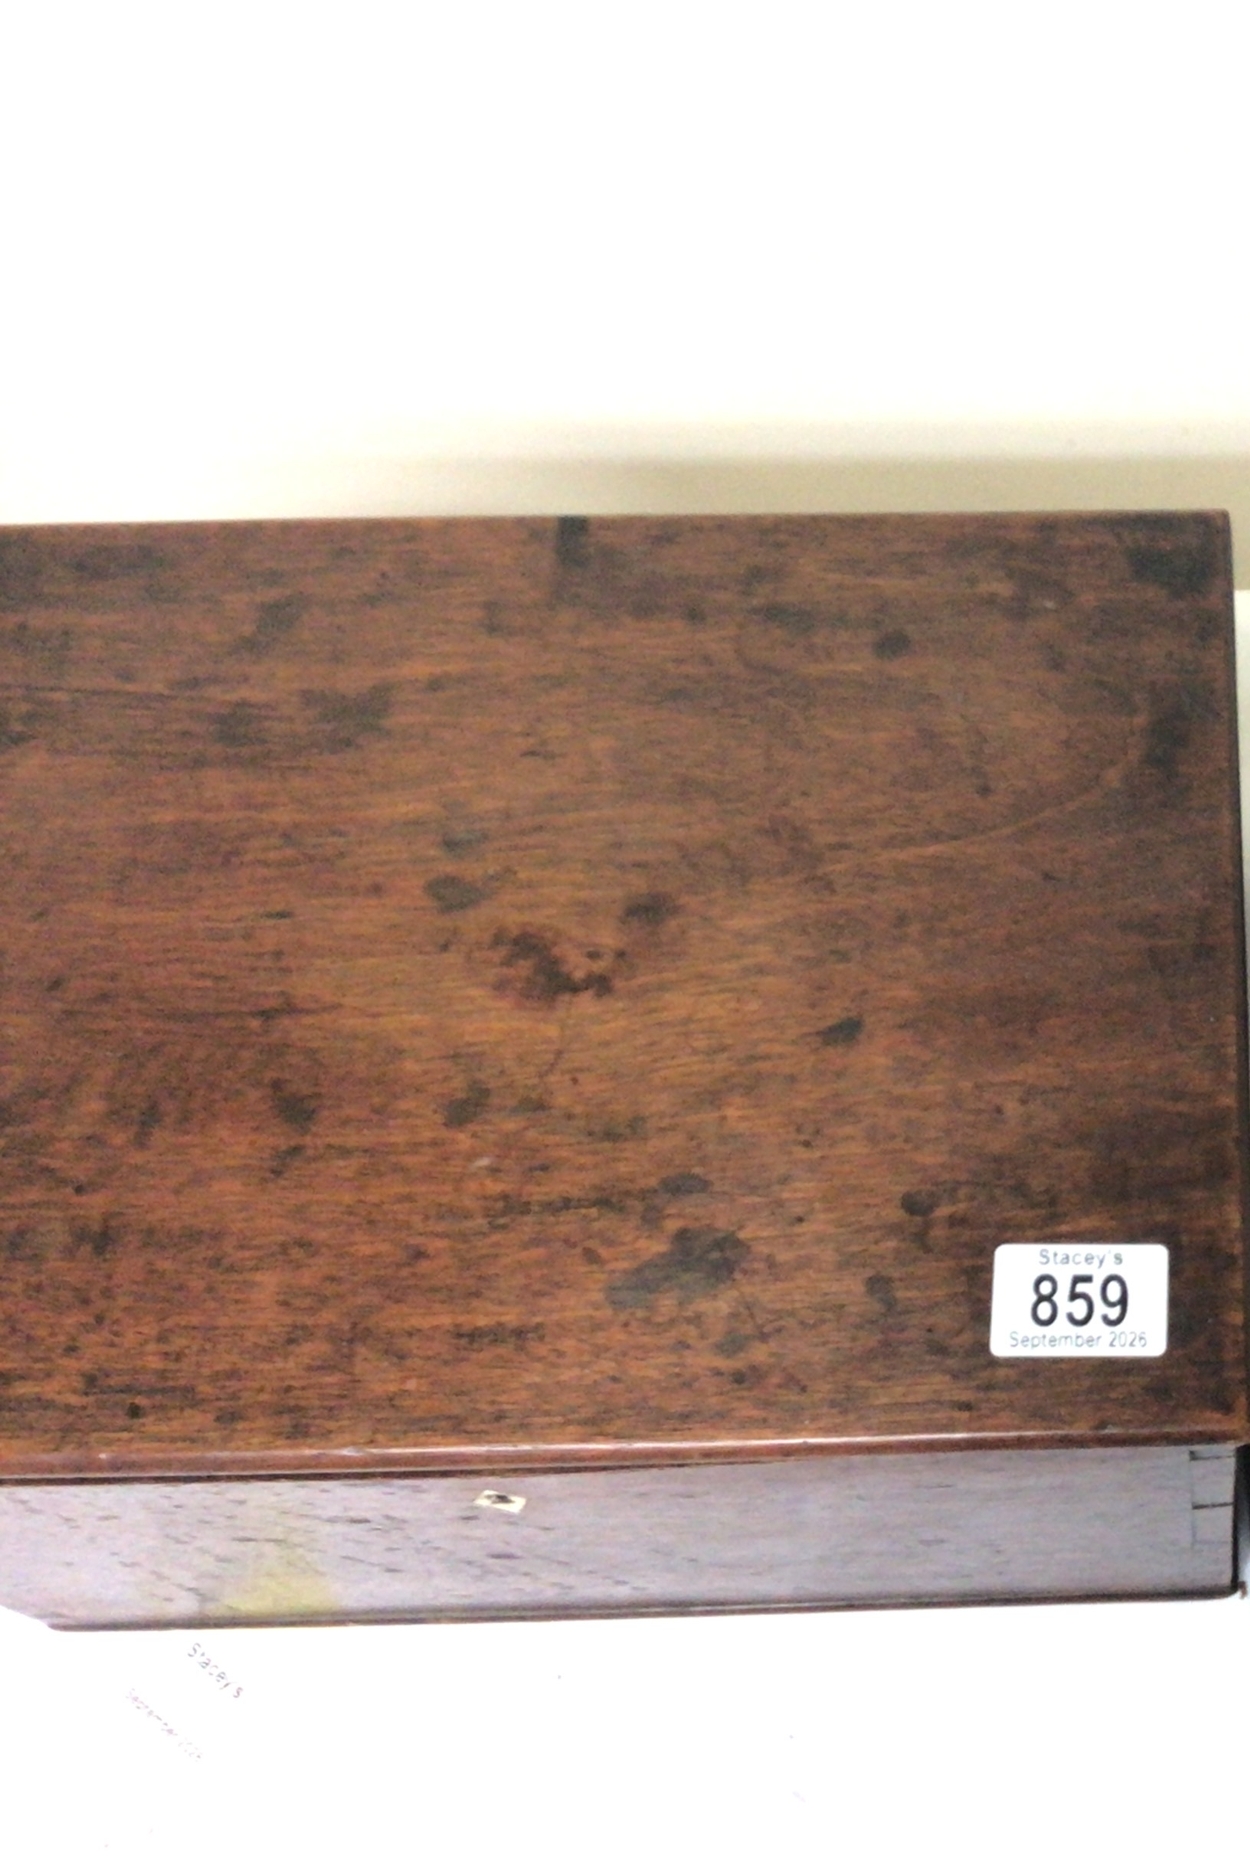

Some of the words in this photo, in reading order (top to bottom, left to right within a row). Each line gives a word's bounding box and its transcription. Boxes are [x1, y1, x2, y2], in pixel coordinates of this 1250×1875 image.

[1039, 1249, 1123, 1268] Stacey's
[1031, 1273, 1129, 1327] 859
[1009, 1331, 1102, 1349] September
